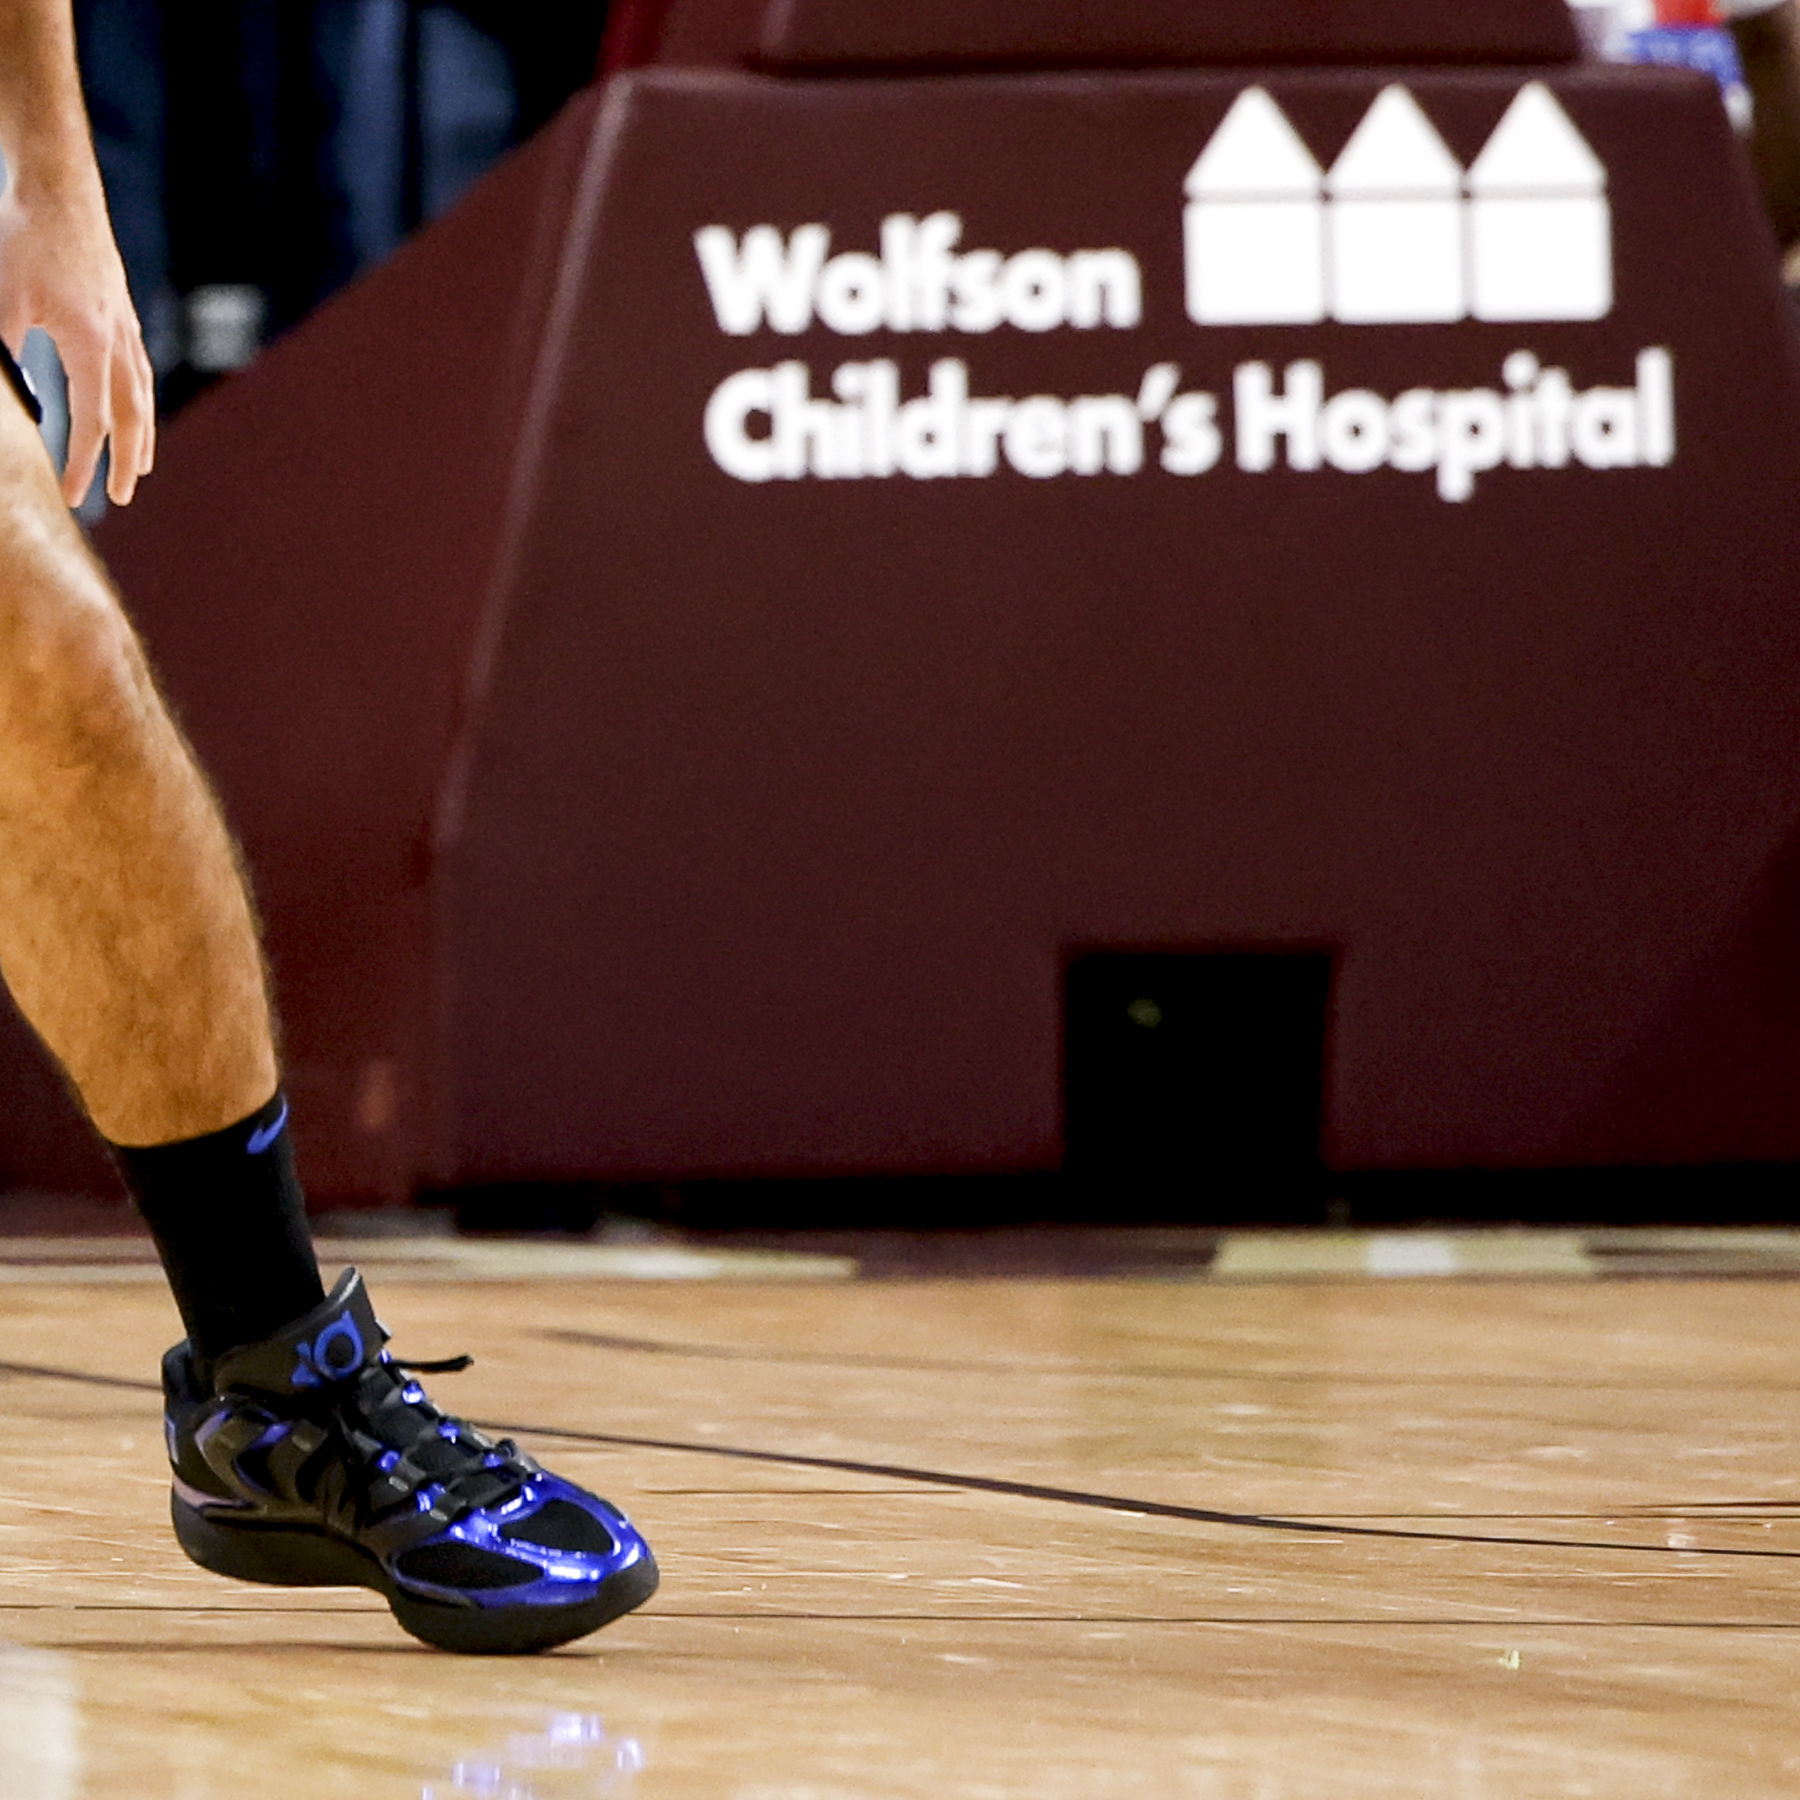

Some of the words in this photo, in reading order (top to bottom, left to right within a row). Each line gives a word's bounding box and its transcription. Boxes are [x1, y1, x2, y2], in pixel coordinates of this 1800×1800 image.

[694, 211, 1142, 335] Wolfson
[704, 358, 1223, 483] Children's
[1233, 346, 1675, 503] Hospital
